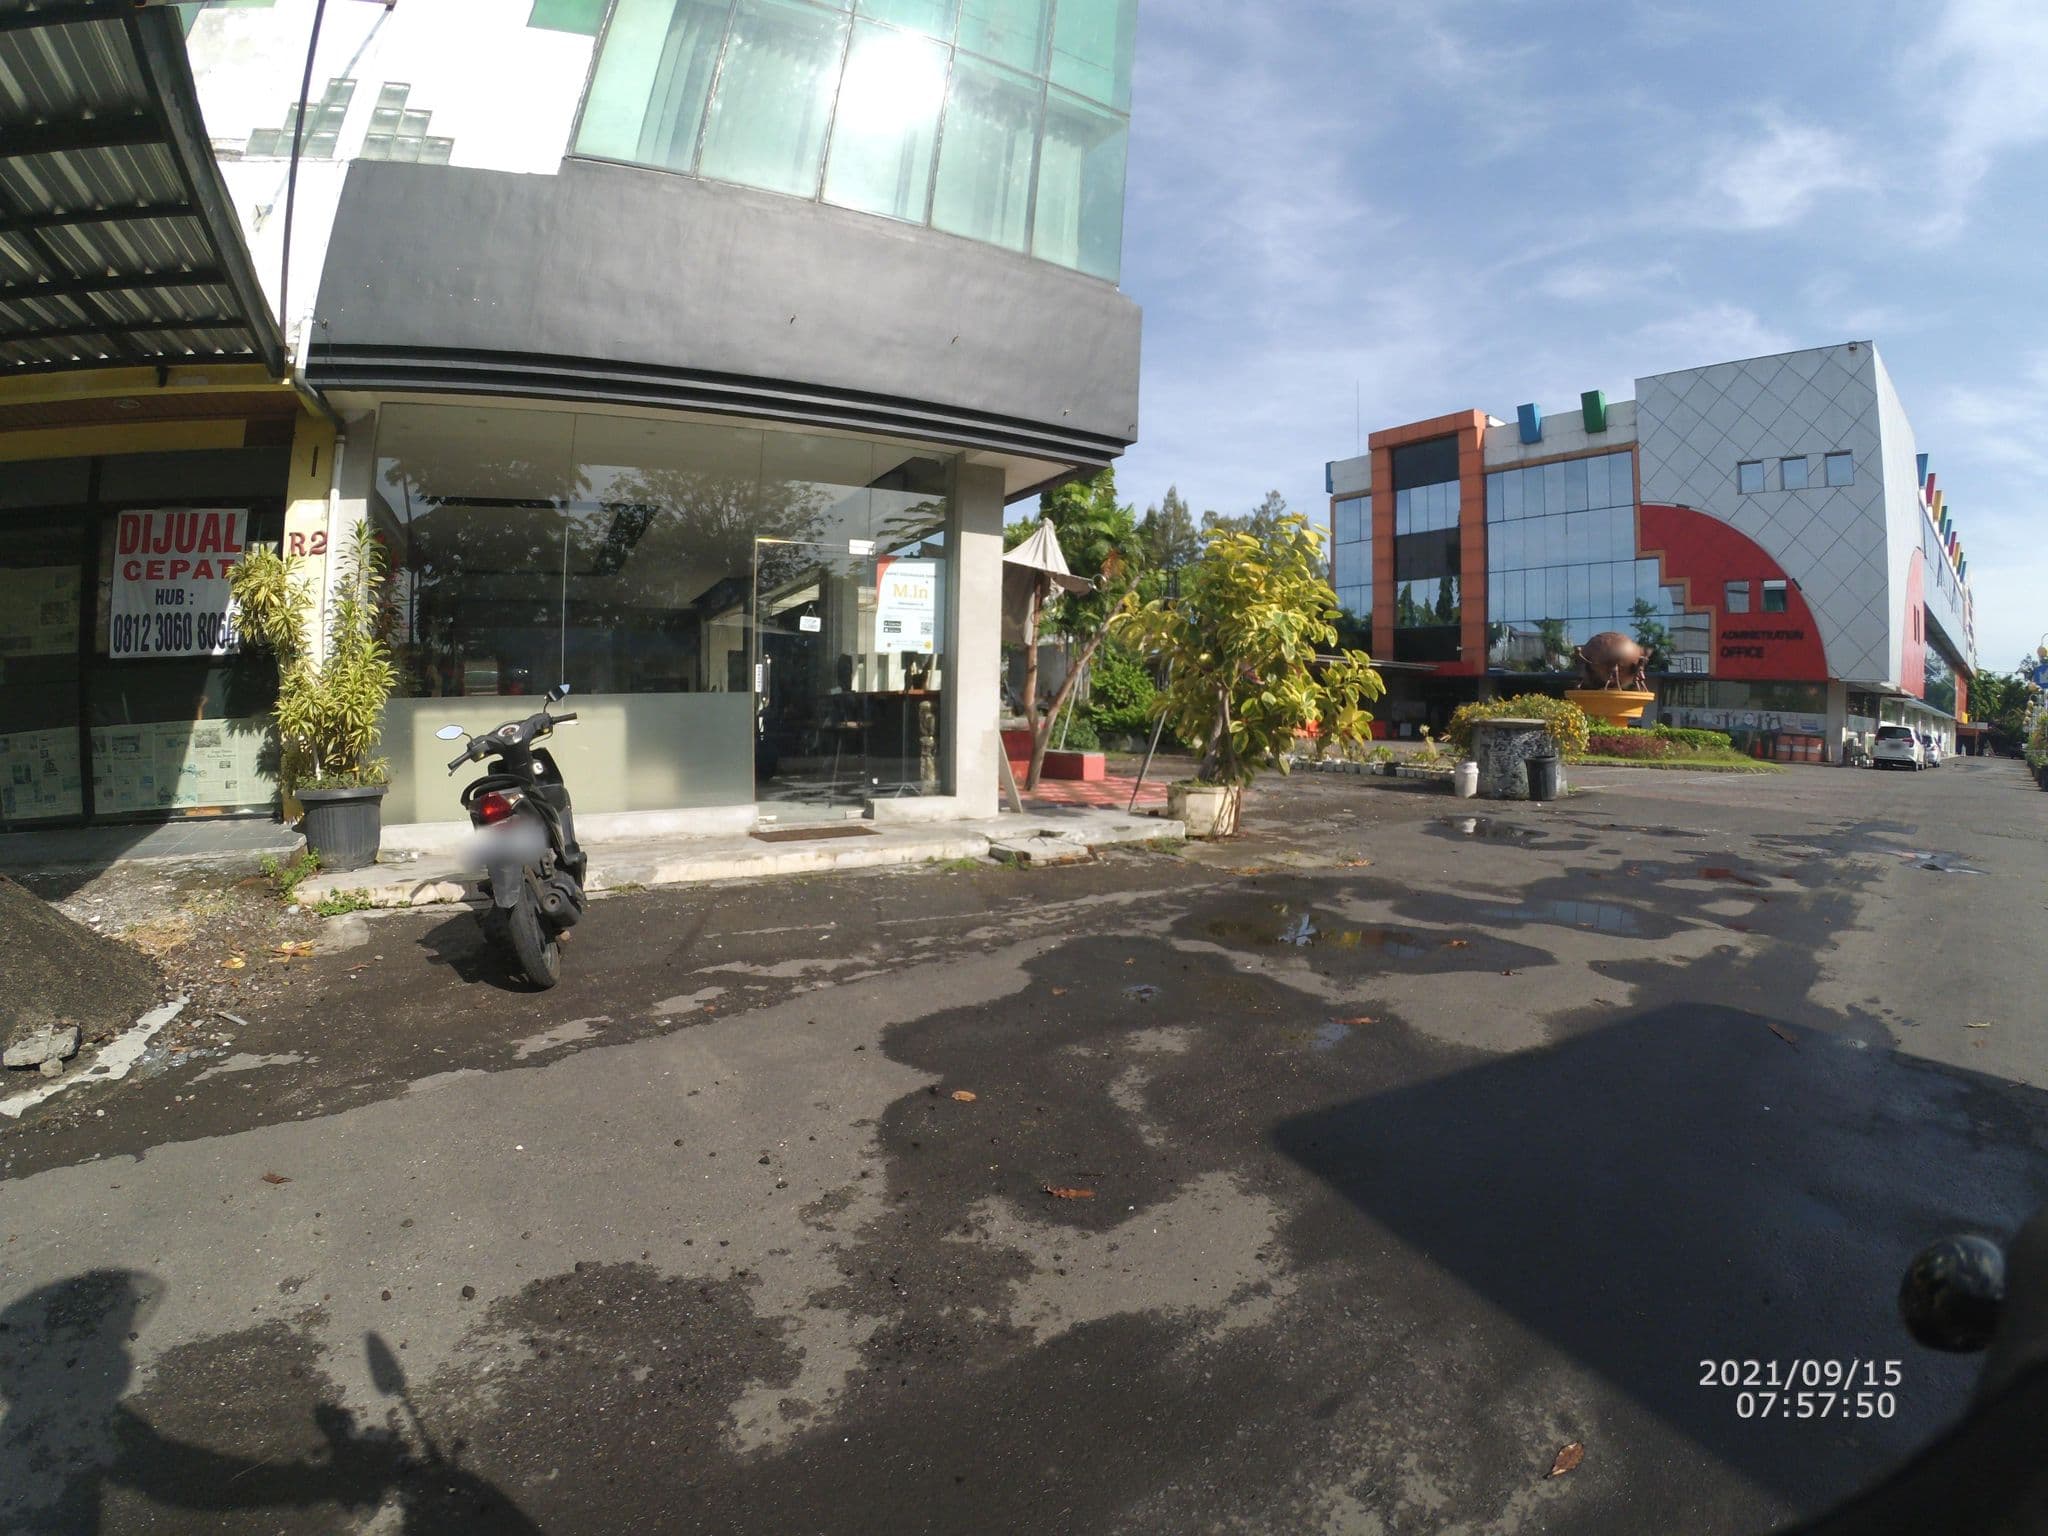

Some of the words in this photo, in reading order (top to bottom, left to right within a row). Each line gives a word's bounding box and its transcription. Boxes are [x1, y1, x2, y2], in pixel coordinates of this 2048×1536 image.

[118, 512, 242, 555] DIJUAL
[289, 531, 328, 557] R2
[122, 559, 235, 582] CEPAT
[155, 588, 184, 606] HUB
[113, 612, 151, 653] 0812
[155, 611, 192, 651] 3060
[1721, 646, 1764, 658] OFFICE
